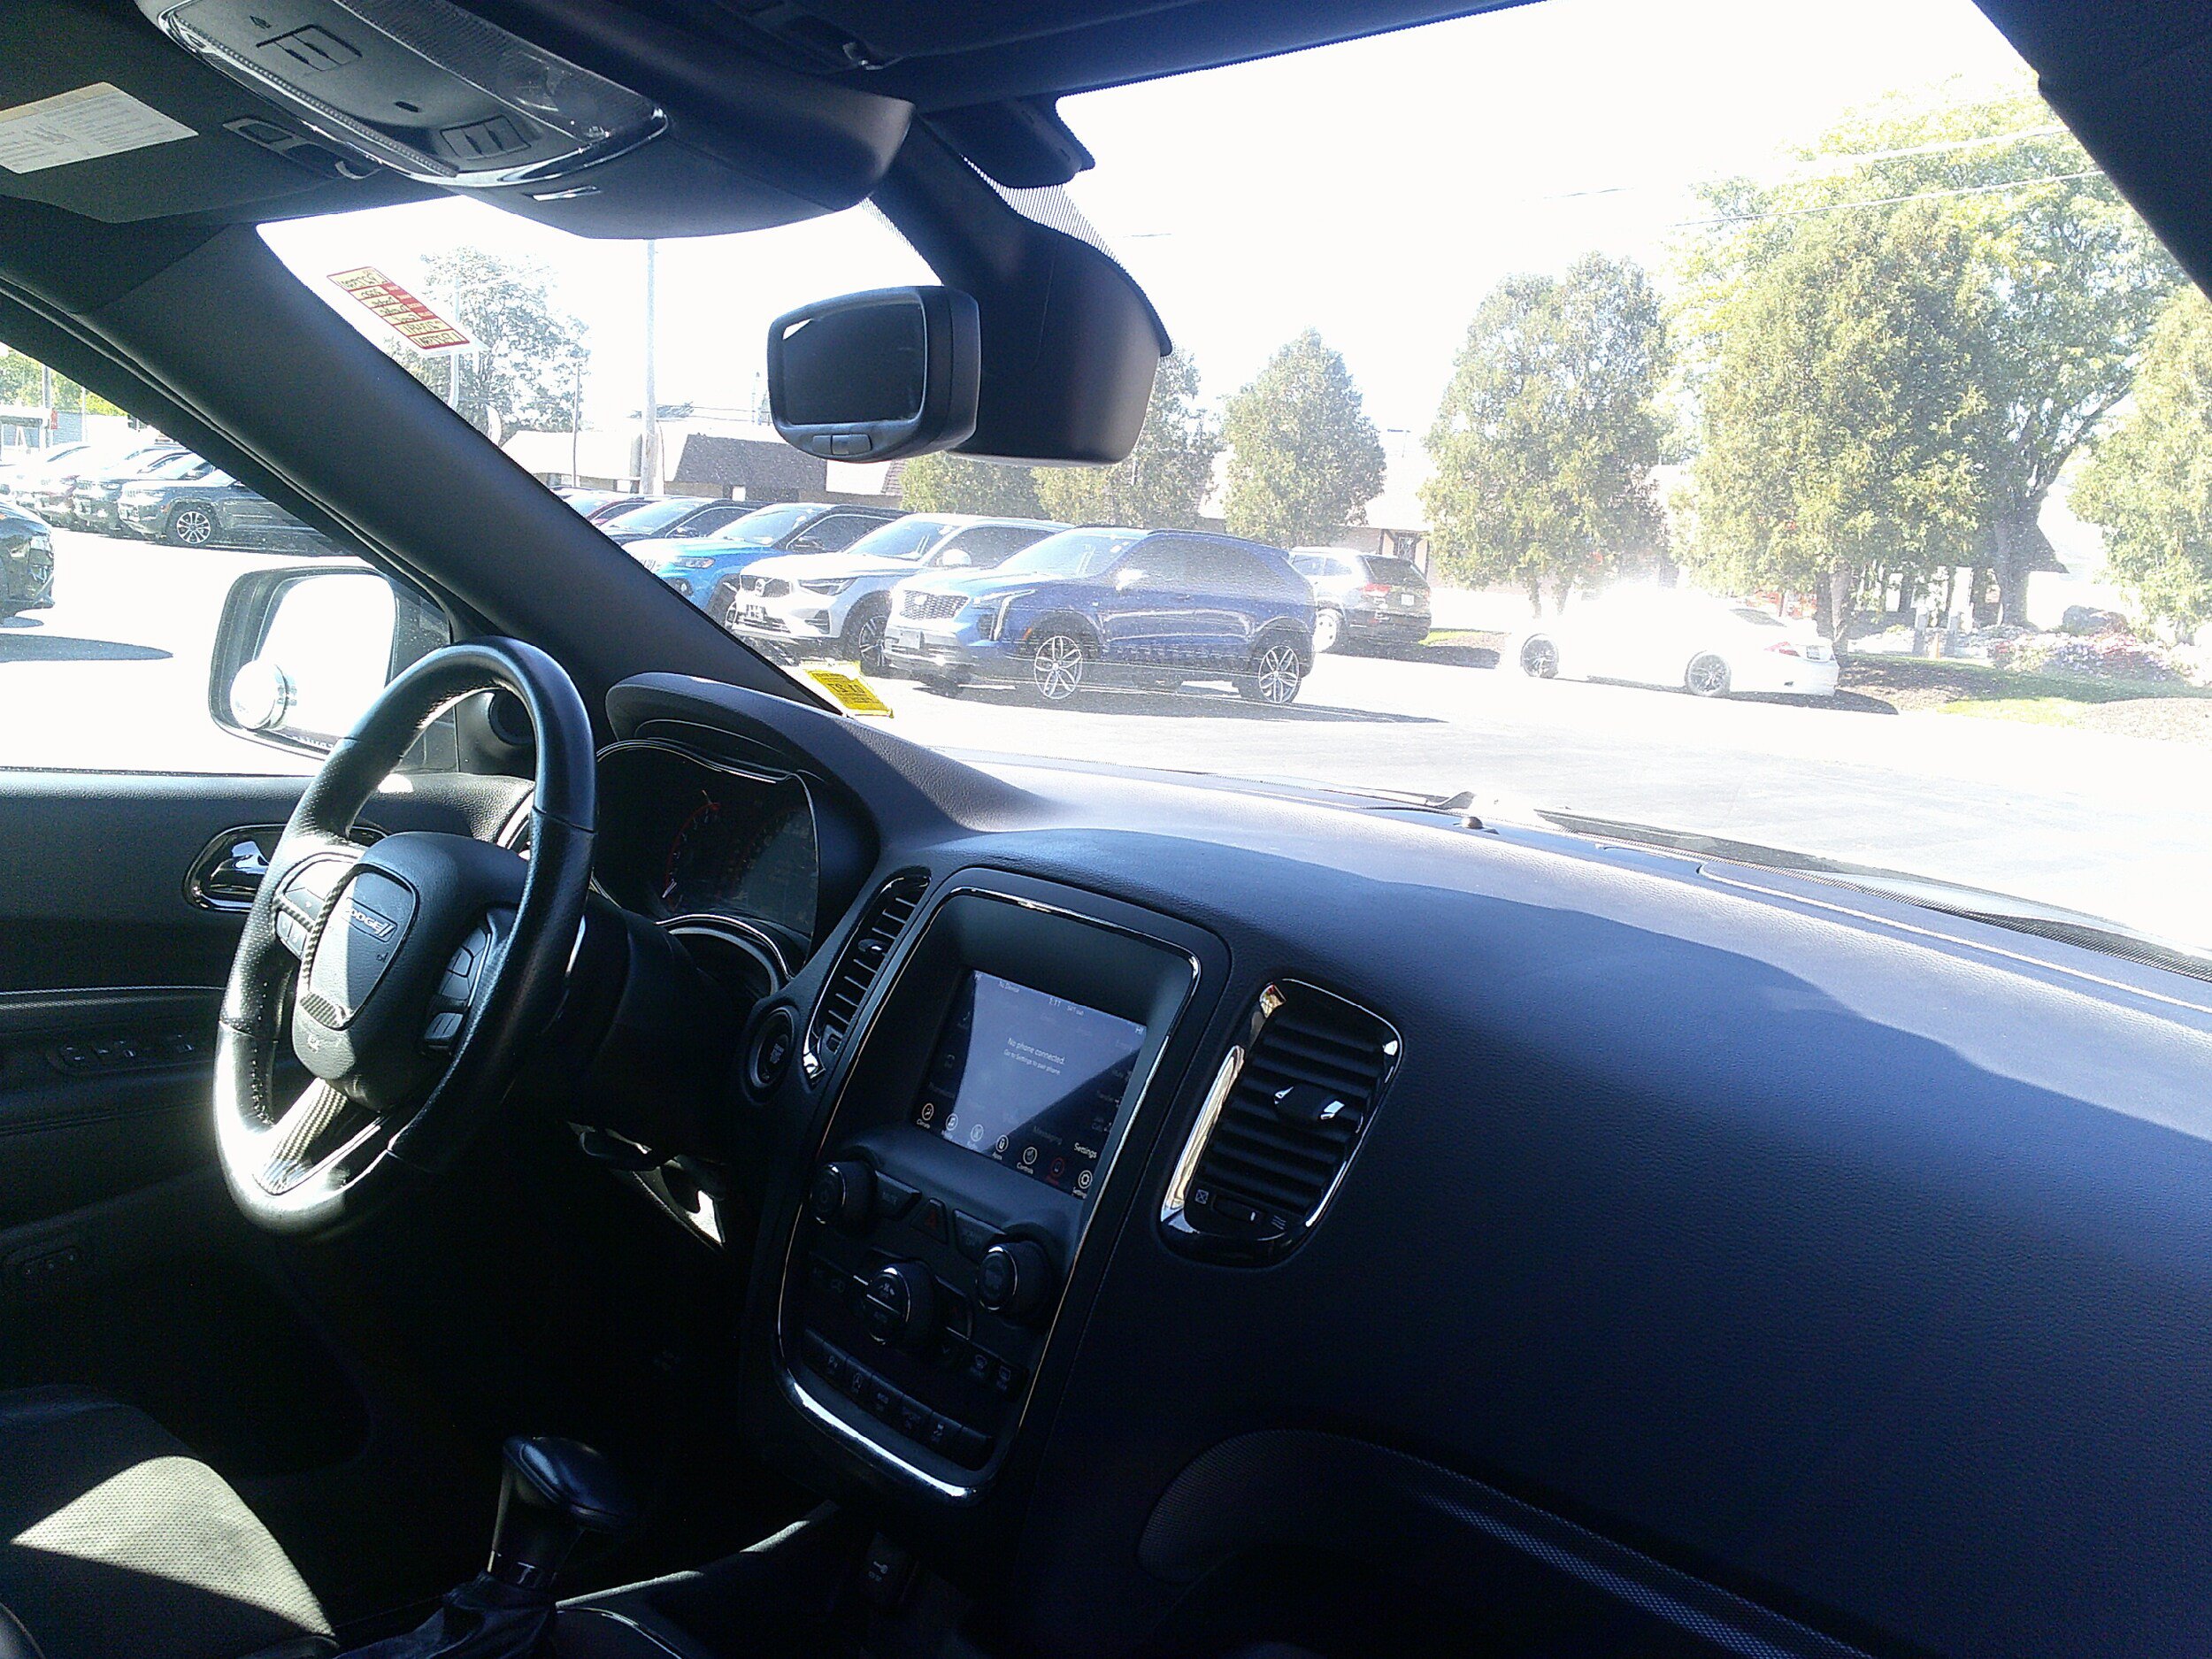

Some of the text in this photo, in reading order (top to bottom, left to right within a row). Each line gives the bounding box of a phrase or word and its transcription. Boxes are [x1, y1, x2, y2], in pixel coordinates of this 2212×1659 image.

[342, 907, 384, 933] ODGE
[1016, 1041, 1035, 1054] phone
[1073, 1141, 1097, 1159] Settings
[1017, 1162, 1033, 1175] Controls
